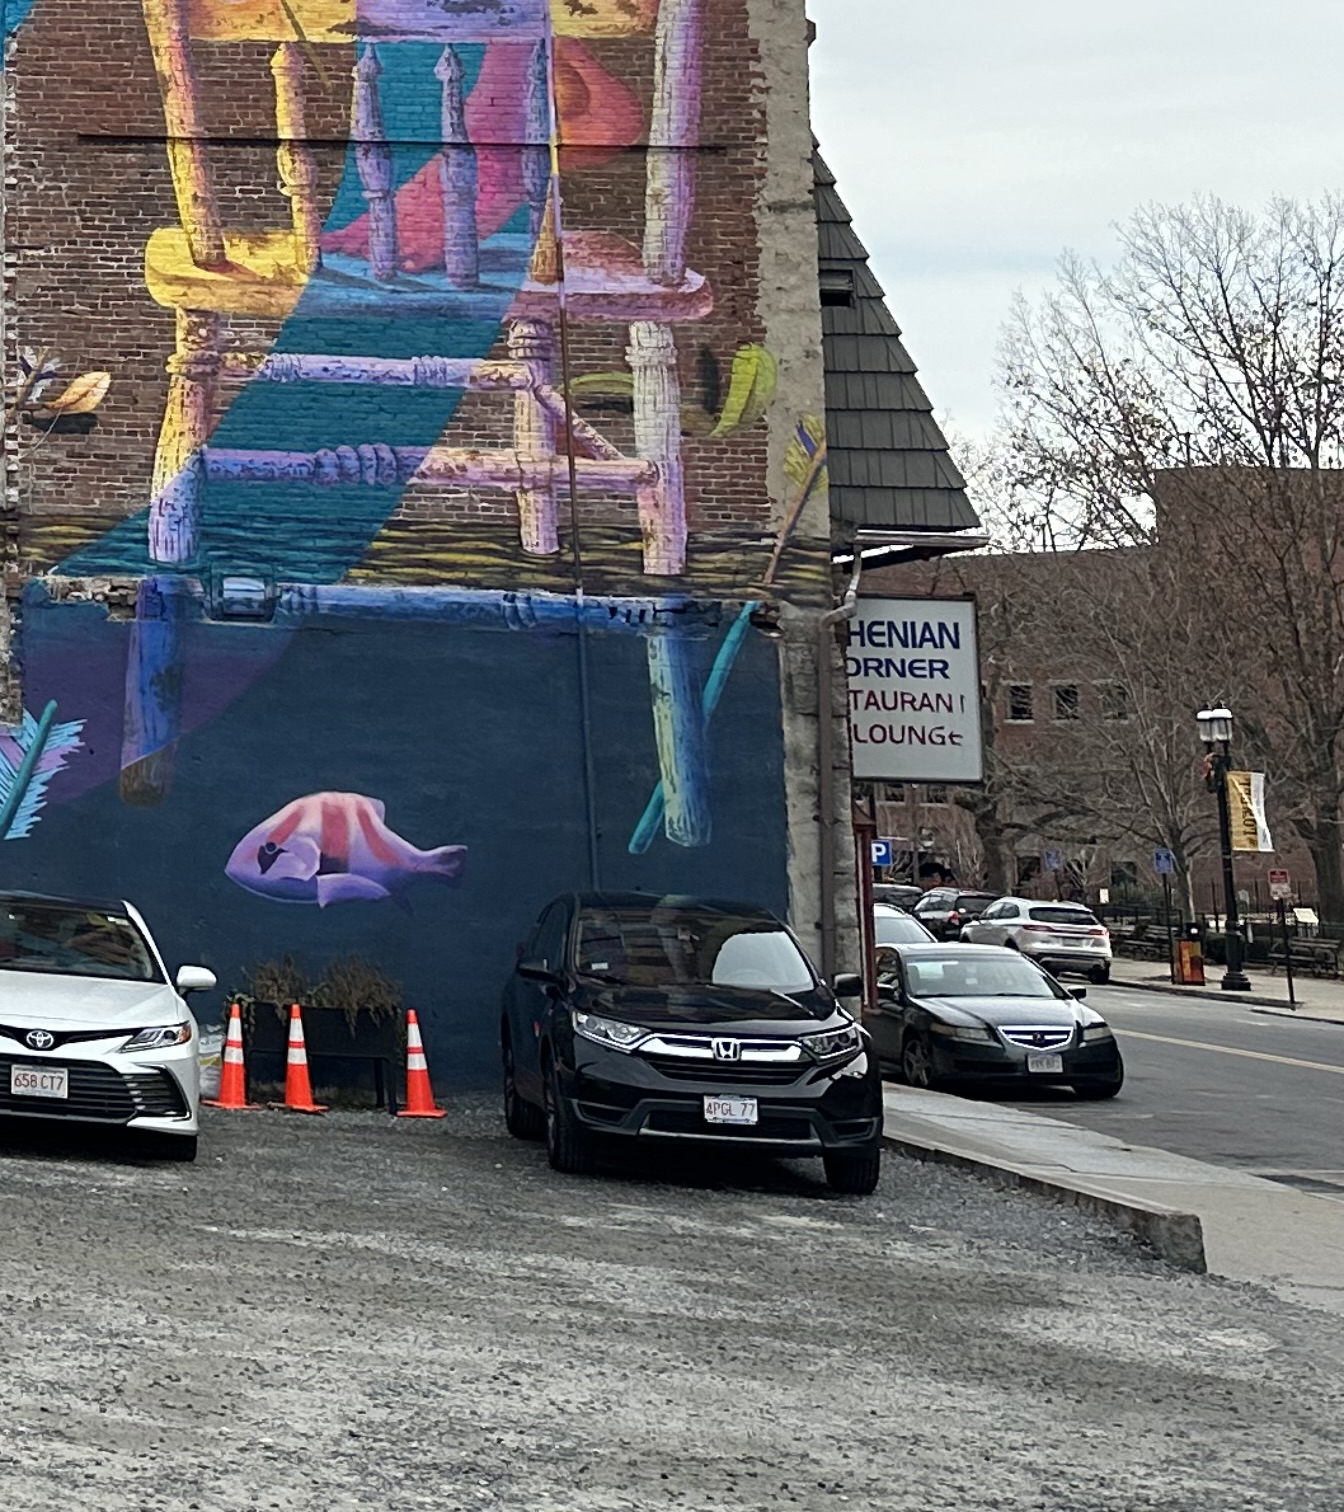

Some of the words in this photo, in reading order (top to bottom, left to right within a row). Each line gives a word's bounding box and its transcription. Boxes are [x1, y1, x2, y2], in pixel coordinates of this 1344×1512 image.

[853, 724, 963, 746] LOUNGE
[872, 843, 887, 863] P
[15, 1073, 37, 1088] 658
[41, 1074, 64, 1090] CT7
[741, 1102, 755, 1117] 77
